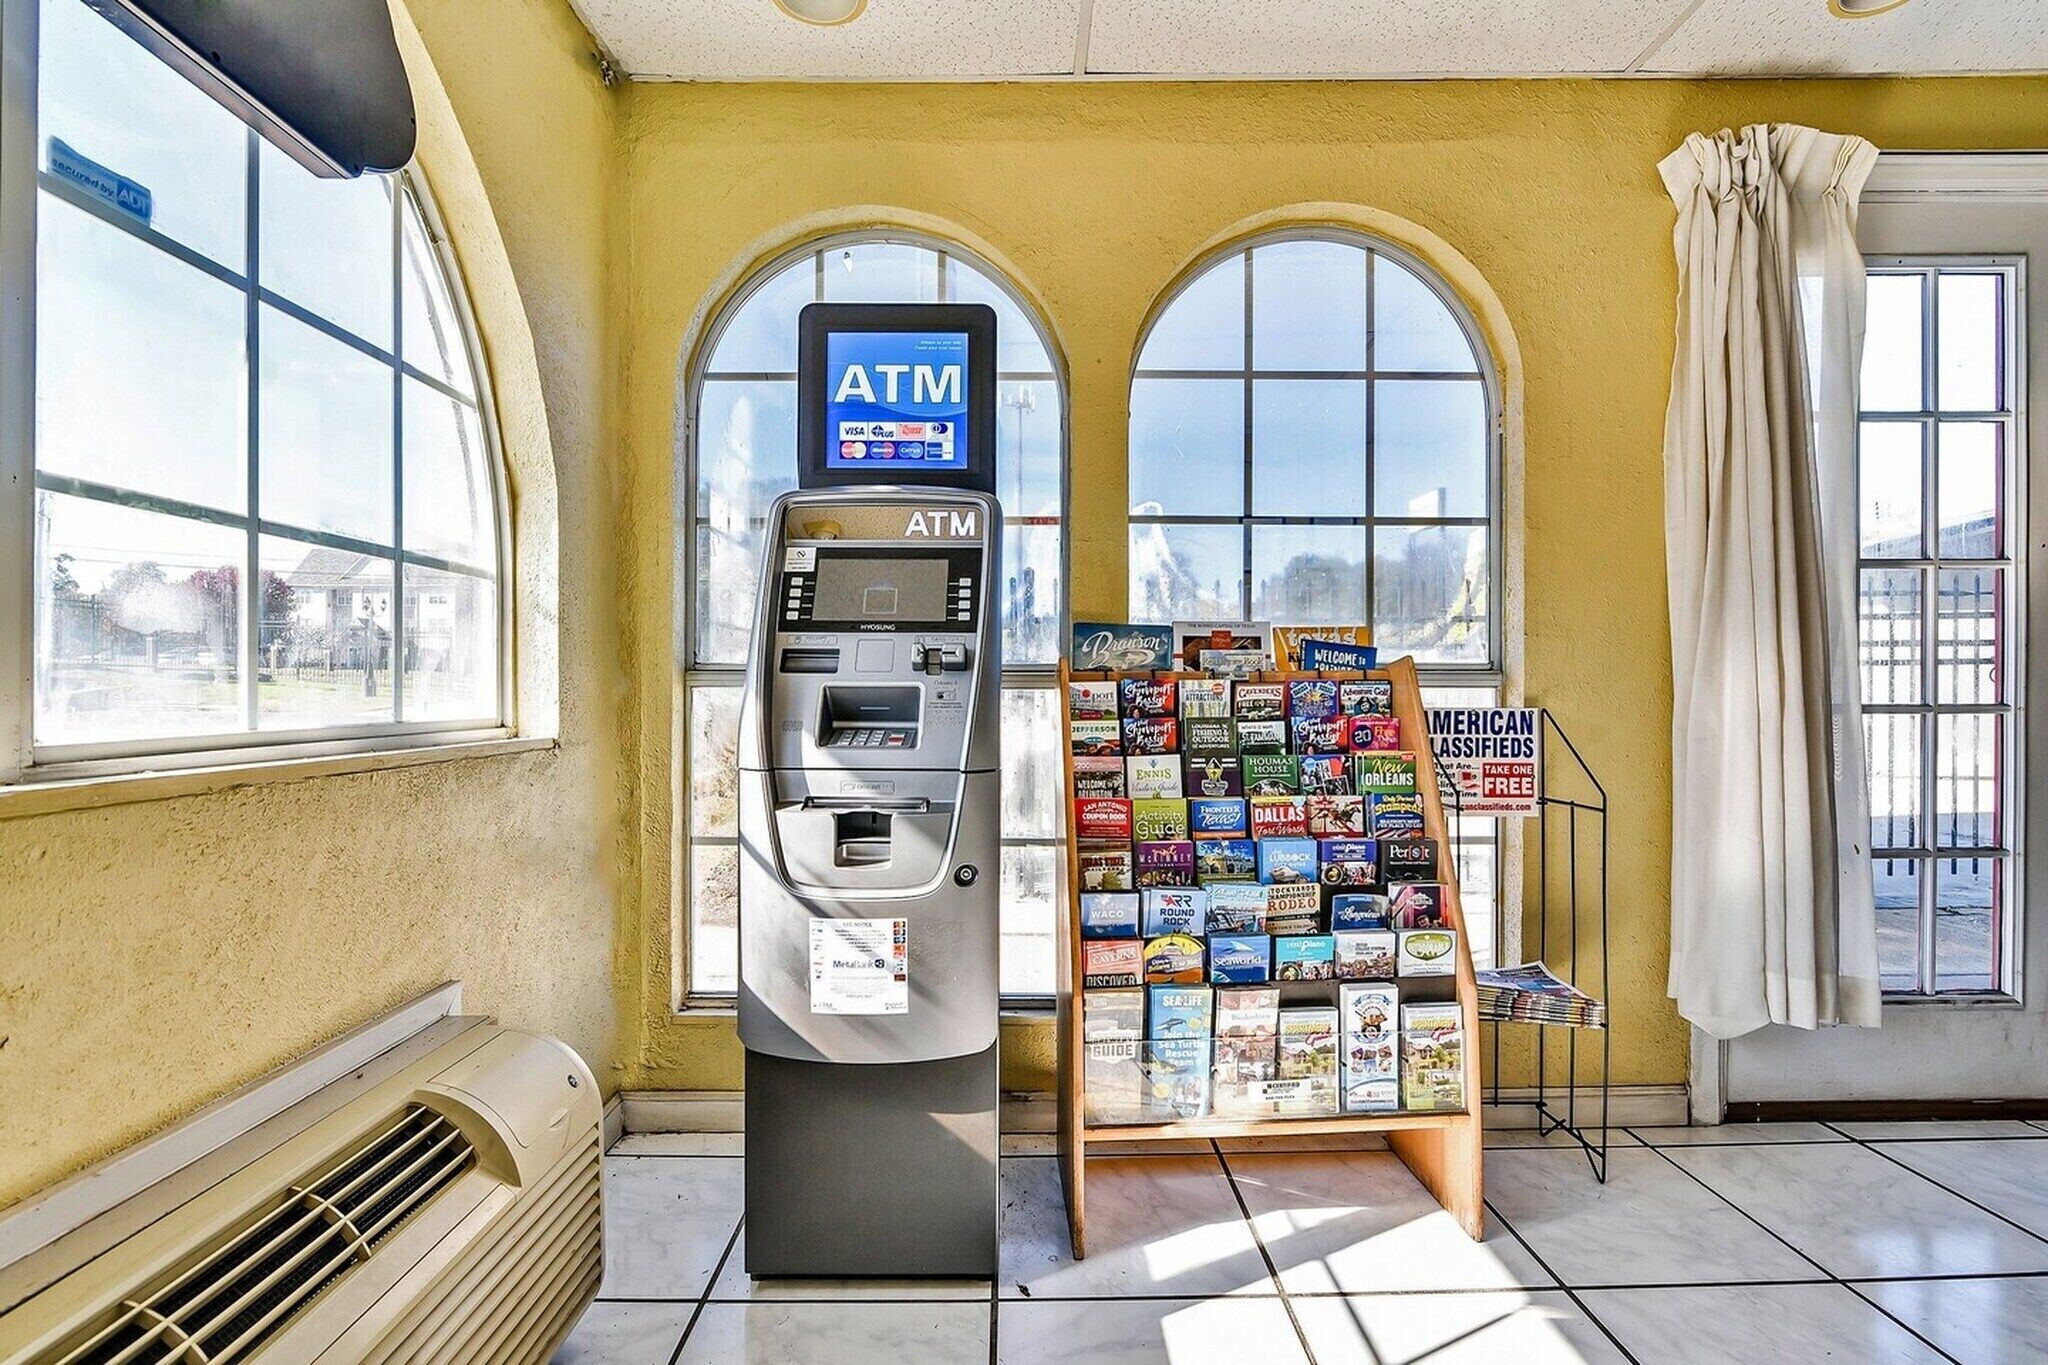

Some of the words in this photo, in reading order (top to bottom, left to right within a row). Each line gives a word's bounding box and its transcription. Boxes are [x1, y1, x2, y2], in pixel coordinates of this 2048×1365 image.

[52, 158, 99, 189] secured
[100, 183, 114, 197] by
[117, 186, 148, 215] ADT
[834, 364, 962, 404] ATM
[844, 426, 866, 436] VISA
[904, 511, 976, 537] ATM
[1314, 648, 1357, 667] WELCOME
[1358, 657, 1367, 666] TO
[1354, 729, 1372, 743] 20
[1430, 737, 1534, 758] LASSIFIEDS
[1249, 757, 1293, 766] HOUMAS
[1373, 759, 1407, 773] New
[1136, 769, 1172, 780] ENNIS
[1254, 766, 1289, 774] HOUSE
[1485, 766, 1509, 774] TAKE
[1513, 765, 1533, 773] ONE
[1366, 772, 1414, 786] ORLEANS
[1484, 777, 1534, 795] FREE
[1083, 803, 1097, 812] SAN
[1098, 801, 1129, 812] ANTONIO
[1461, 803, 1532, 811] canclassifieds.com
[1082, 813, 1109, 821] COUPON
[1136, 808, 1184, 824] Activity
[1255, 805, 1305, 823] DALLAS
[1135, 822, 1187, 839] Guide
[1268, 898, 1316, 911] RODEO
[1092, 909, 1124, 918] WACO
[1160, 908, 1195, 917] ROUND
[1163, 917, 1191, 926] ROCK
[1213, 956, 1261, 966] SeaWorld
[1087, 975, 1136, 987] DISCOVER
[1162, 996, 1183, 1007] SEA
[1184, 996, 1202, 1006] LIFE
[1162, 1031, 1183, 1040] Join
[1185, 1031, 1201, 1039] the
[1157, 1040, 1175, 1049] Sea
[1093, 1044, 1133, 1057] GUIDE
[1165, 1050, 1198, 1058] Rescue
